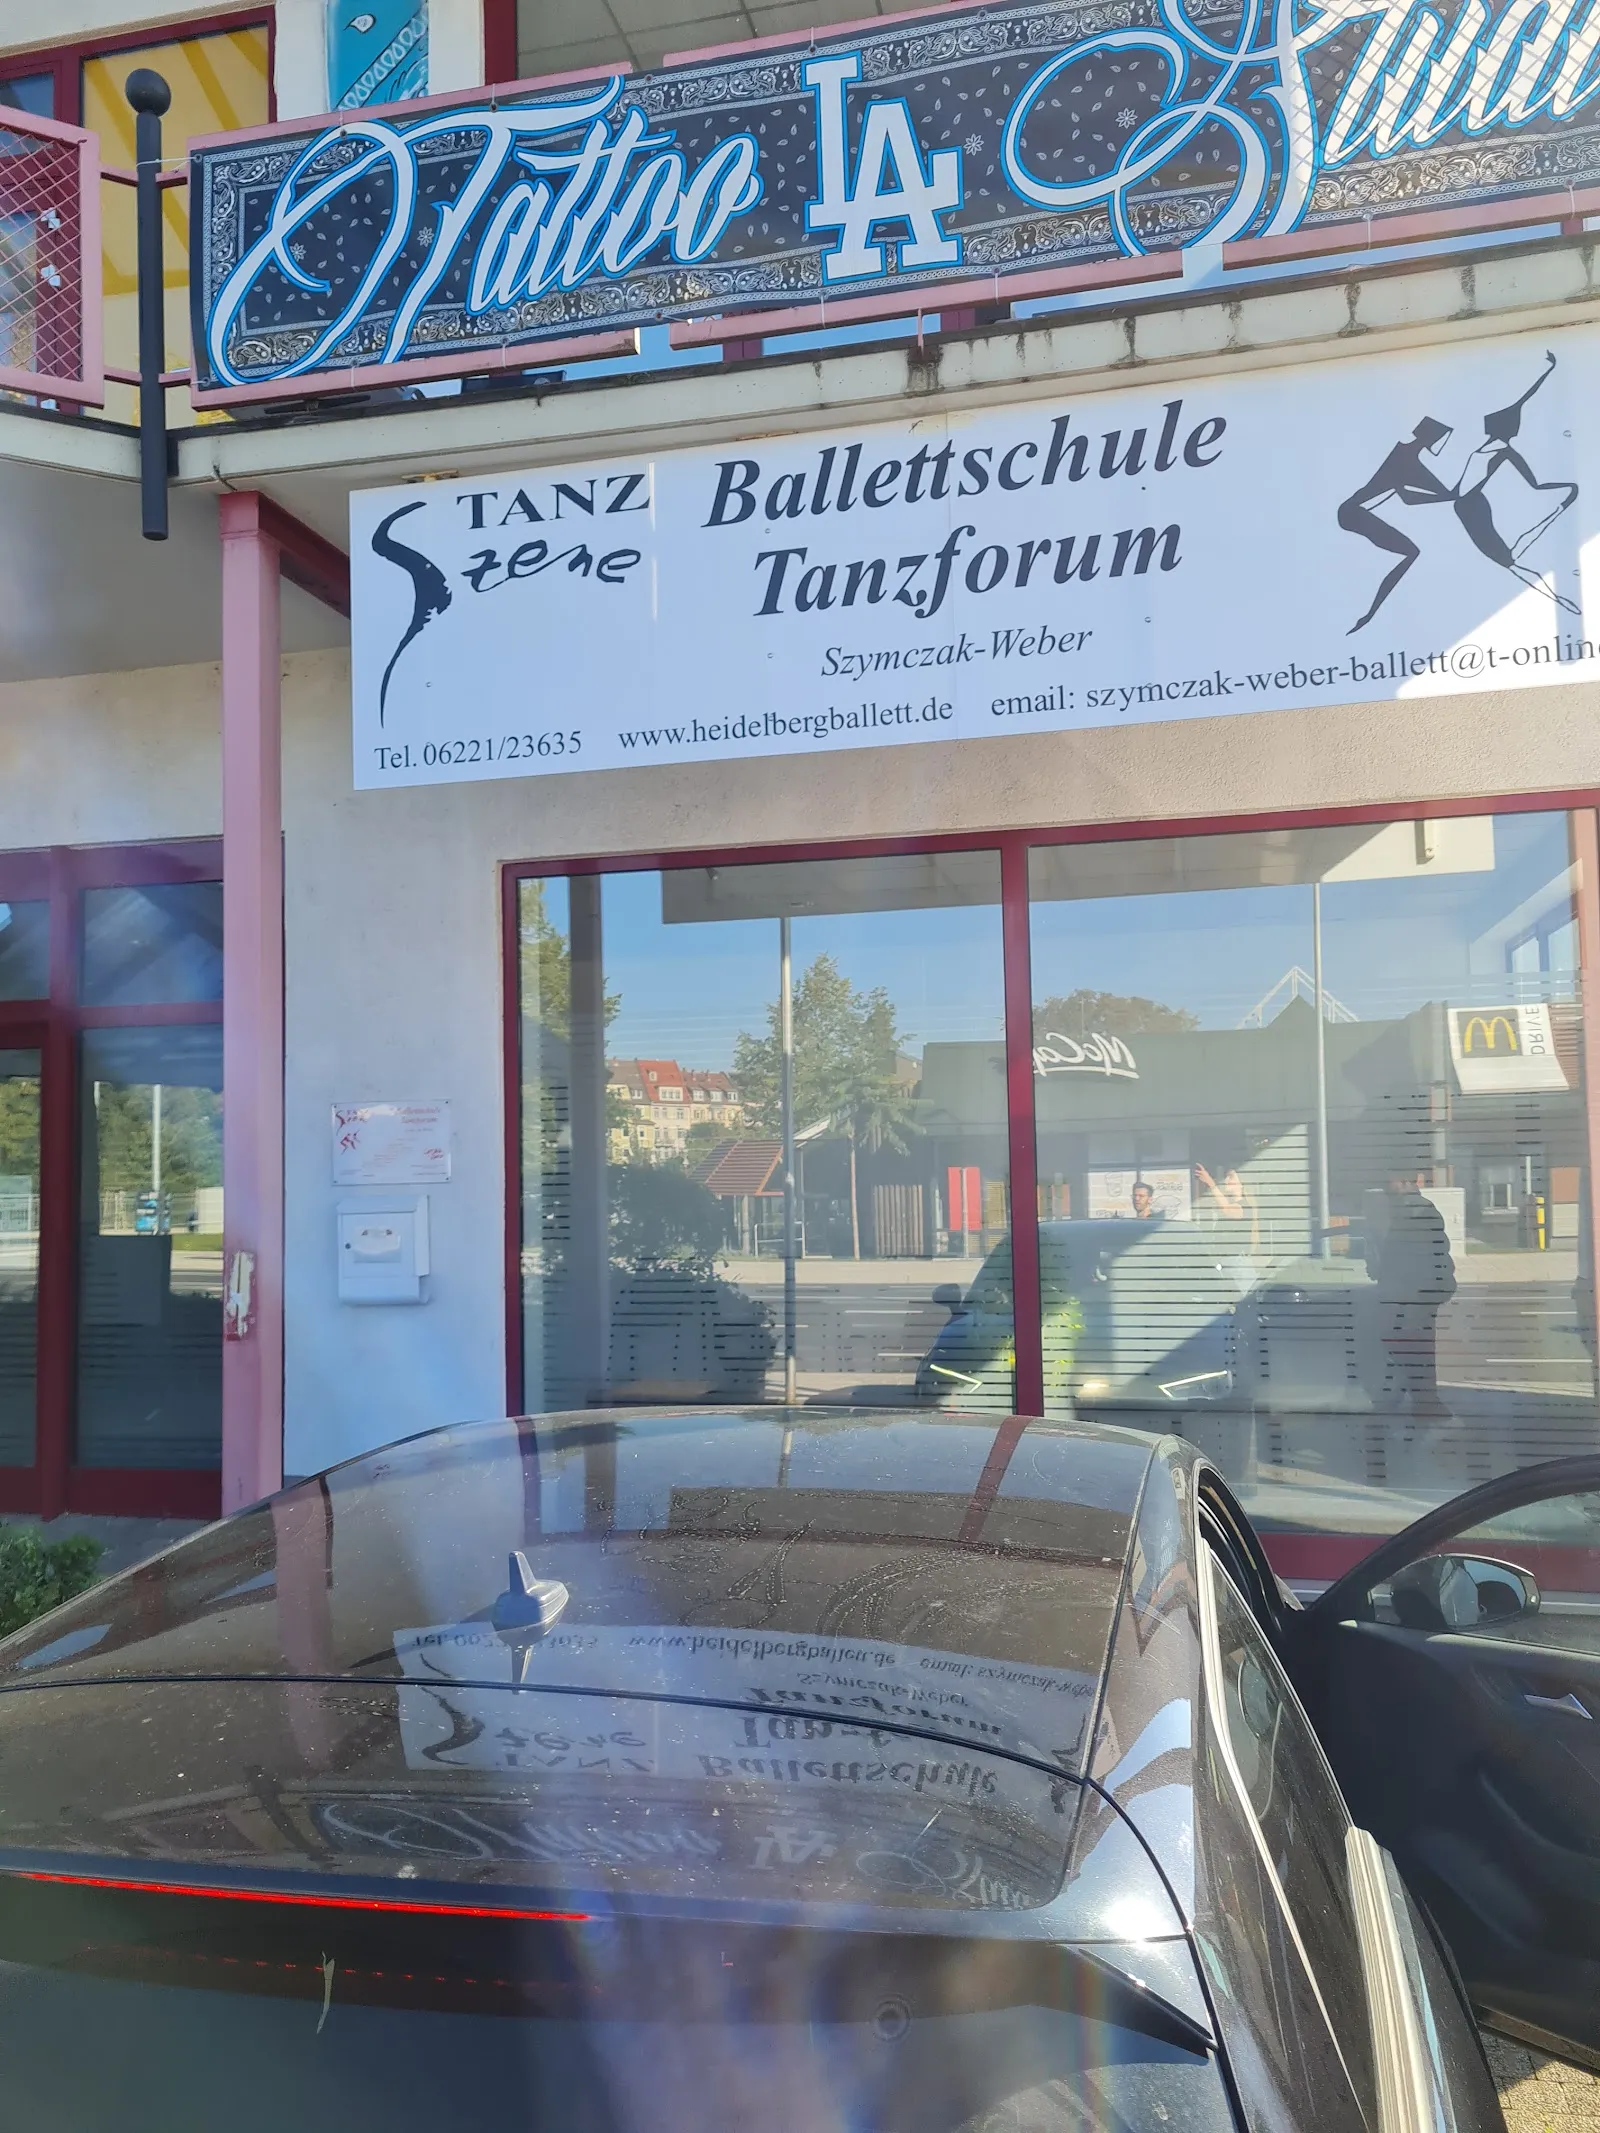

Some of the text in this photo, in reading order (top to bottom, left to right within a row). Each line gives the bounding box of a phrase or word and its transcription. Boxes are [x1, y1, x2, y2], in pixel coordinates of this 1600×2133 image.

[205, 75, 764, 386] Tattoo
[803, 50, 964, 286] LA
[456, 472, 652, 530] TANZ
[700, 399, 1228, 529] Ballettschule
[752, 520, 1183, 620] Tanzforum
[373, 633, 1600, 771] Tel. 06221/23635 www.heidelbergballett.de email: szymczak-weber-ballett@t-onlin
[820, 624, 1094, 681] Szymczak-Weber
